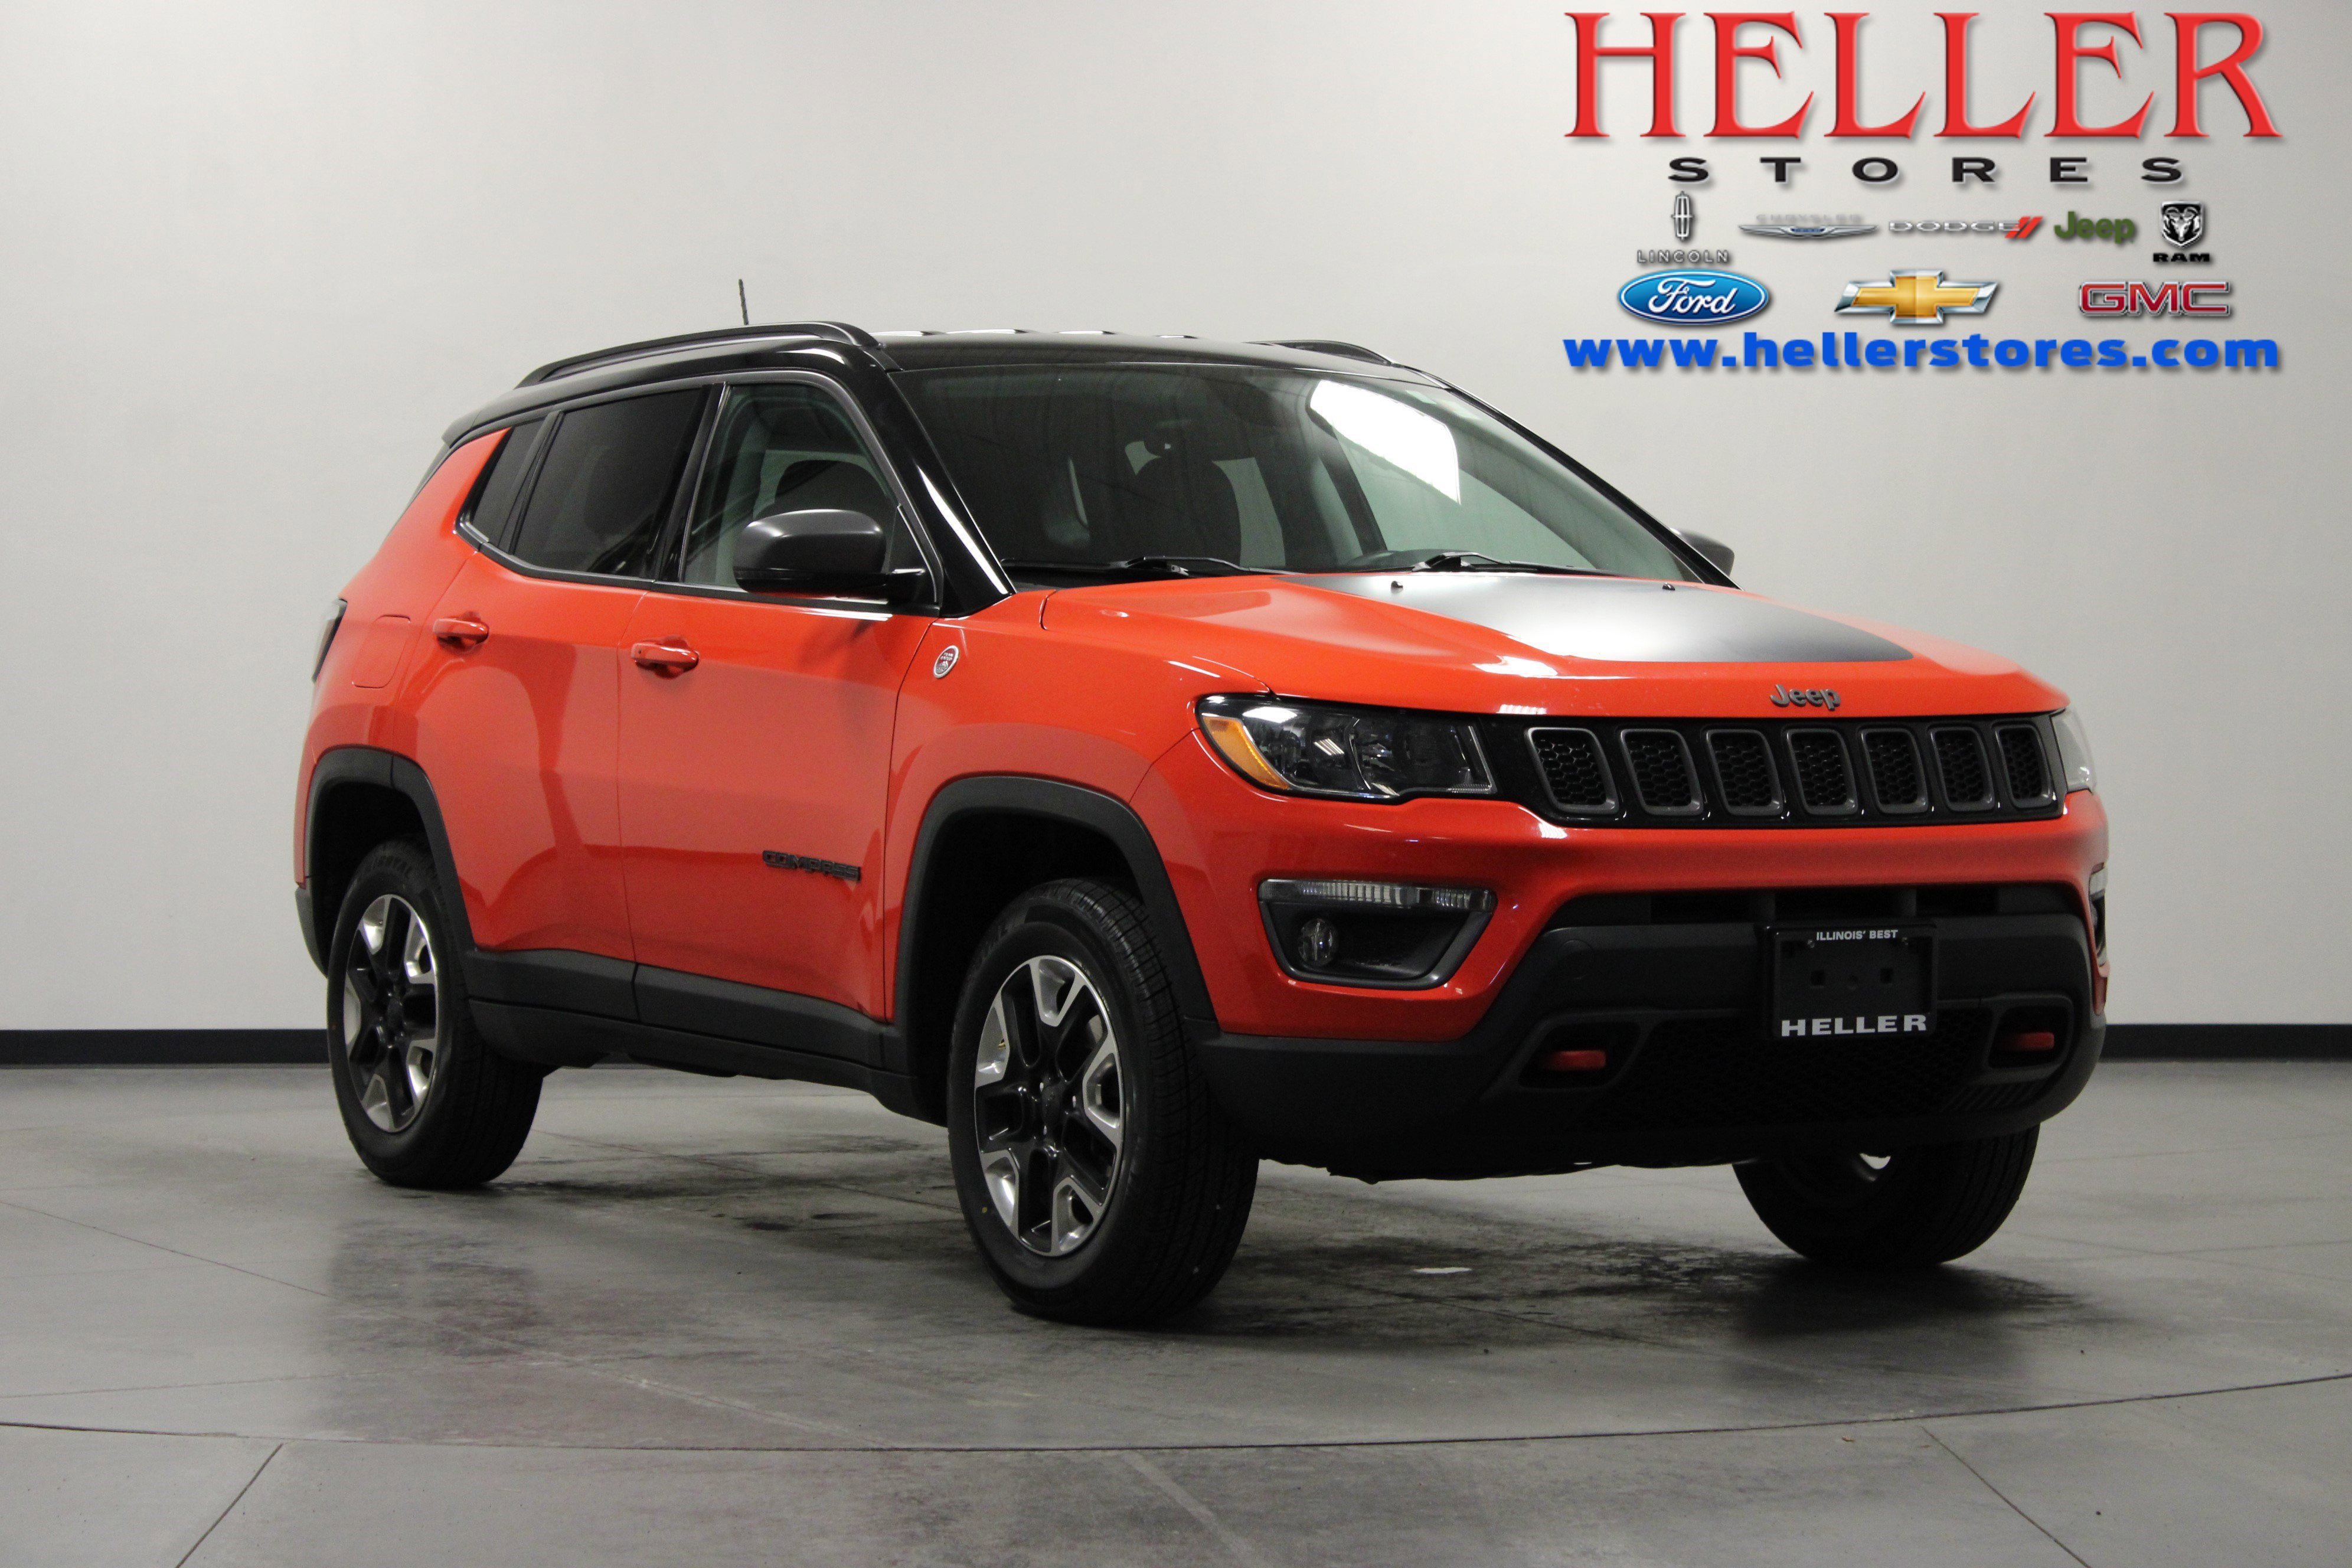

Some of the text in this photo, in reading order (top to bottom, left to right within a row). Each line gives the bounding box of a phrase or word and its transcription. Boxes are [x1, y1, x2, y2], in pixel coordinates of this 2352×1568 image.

[1770, 684, 1841, 711] Jeep
[1816, 929, 1899, 941] ILLINOIS' BEST
[1781, 1014, 1927, 1037] HELLER
